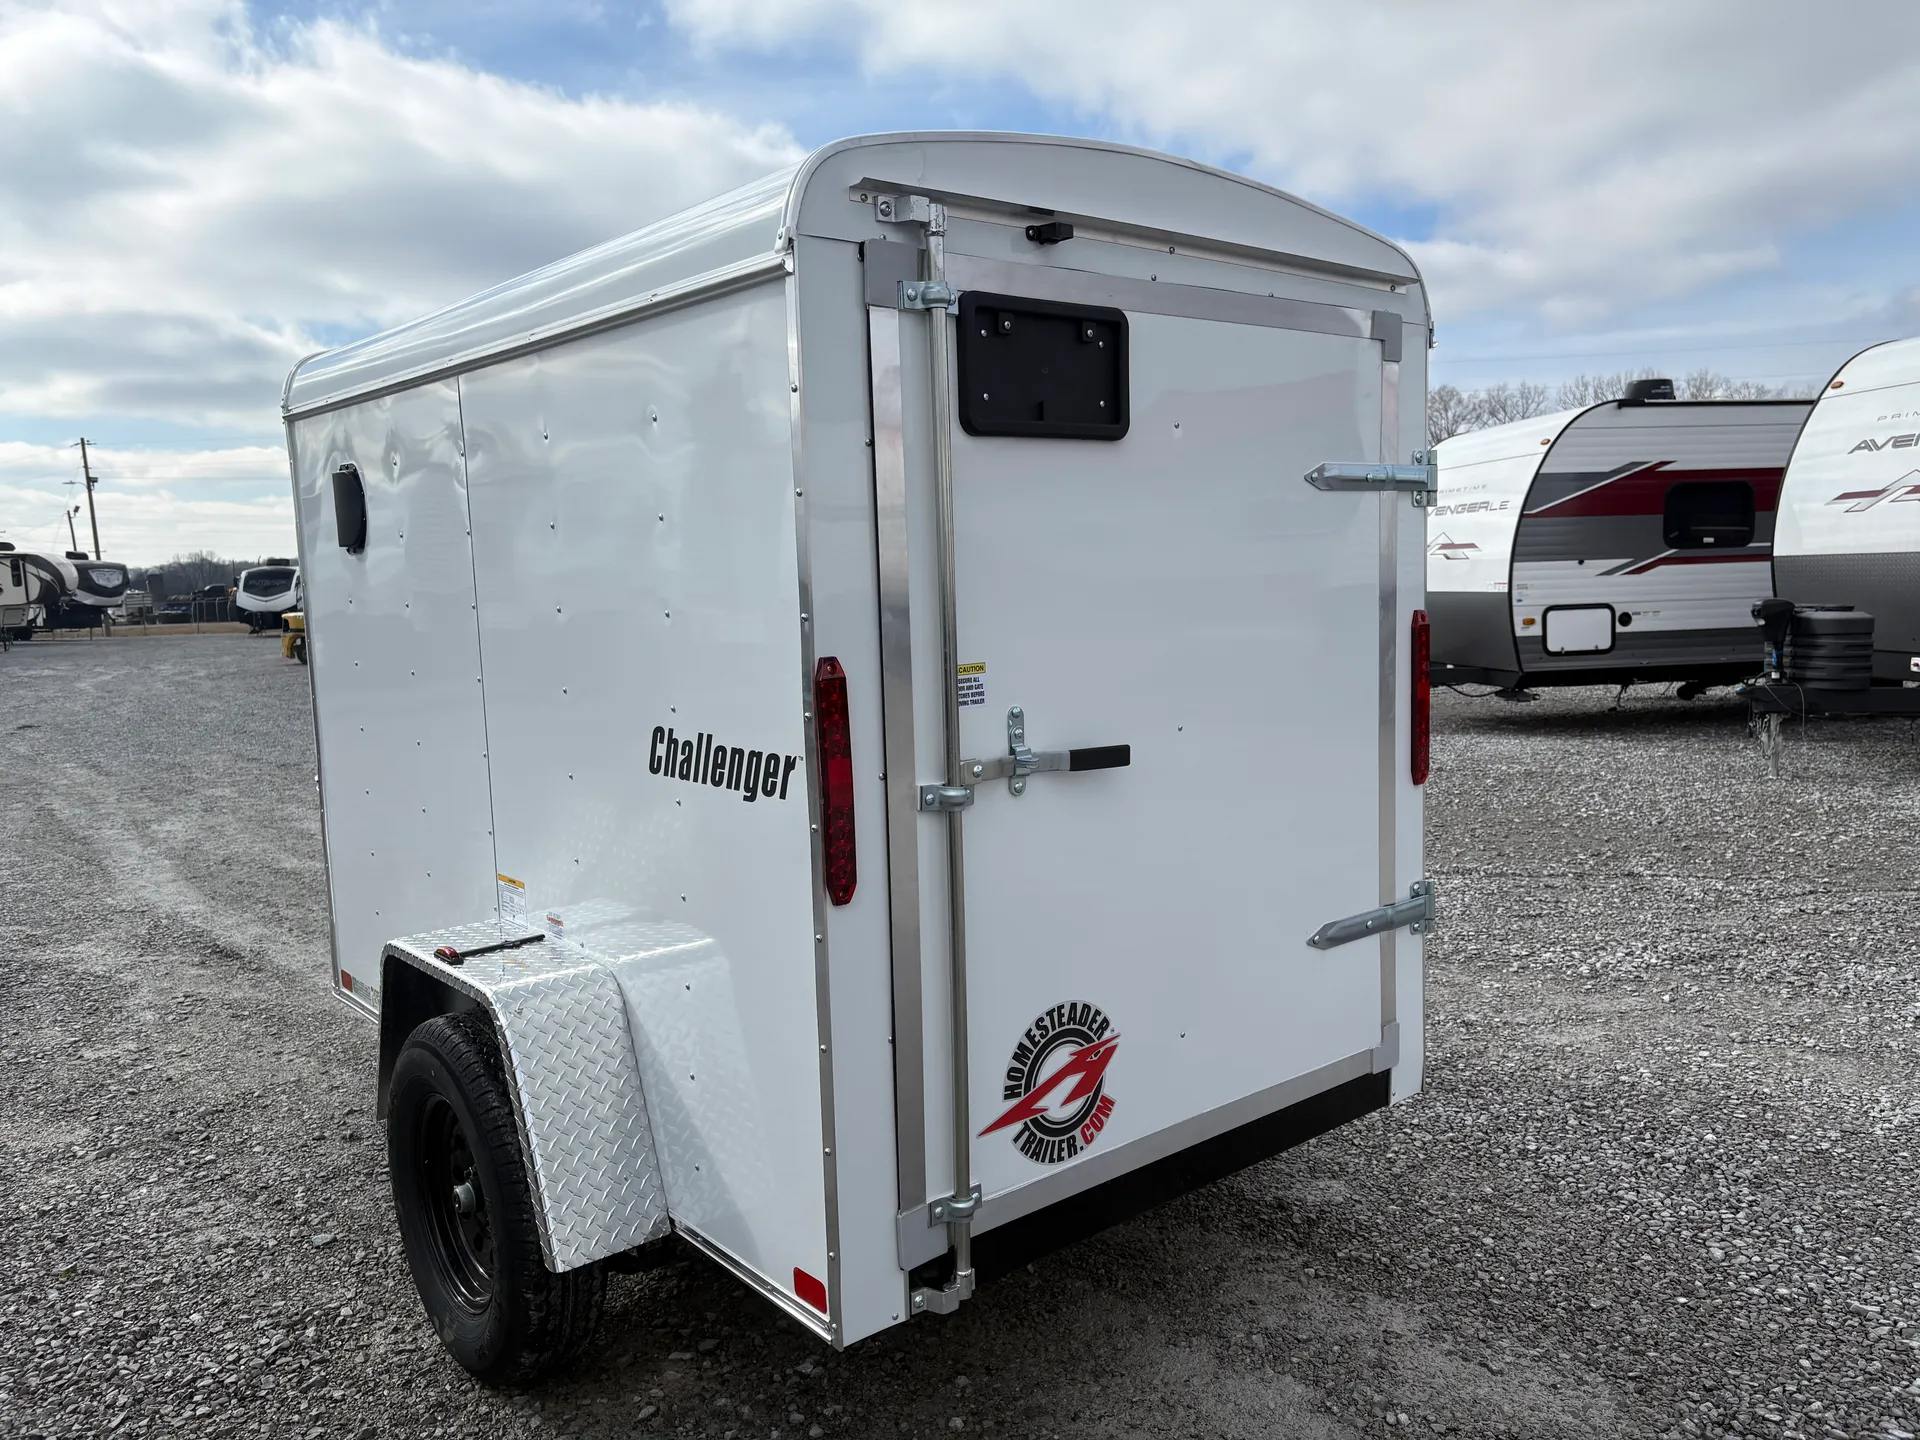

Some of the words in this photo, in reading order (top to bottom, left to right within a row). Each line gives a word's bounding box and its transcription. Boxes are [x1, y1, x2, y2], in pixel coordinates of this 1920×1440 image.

[1438, 484, 1487, 494] RIMETIME
[958, 665, 984, 673] CAUTION
[649, 726, 797, 802] Challenger
[1003, 1002, 1110, 1100] HOMESTEADER
